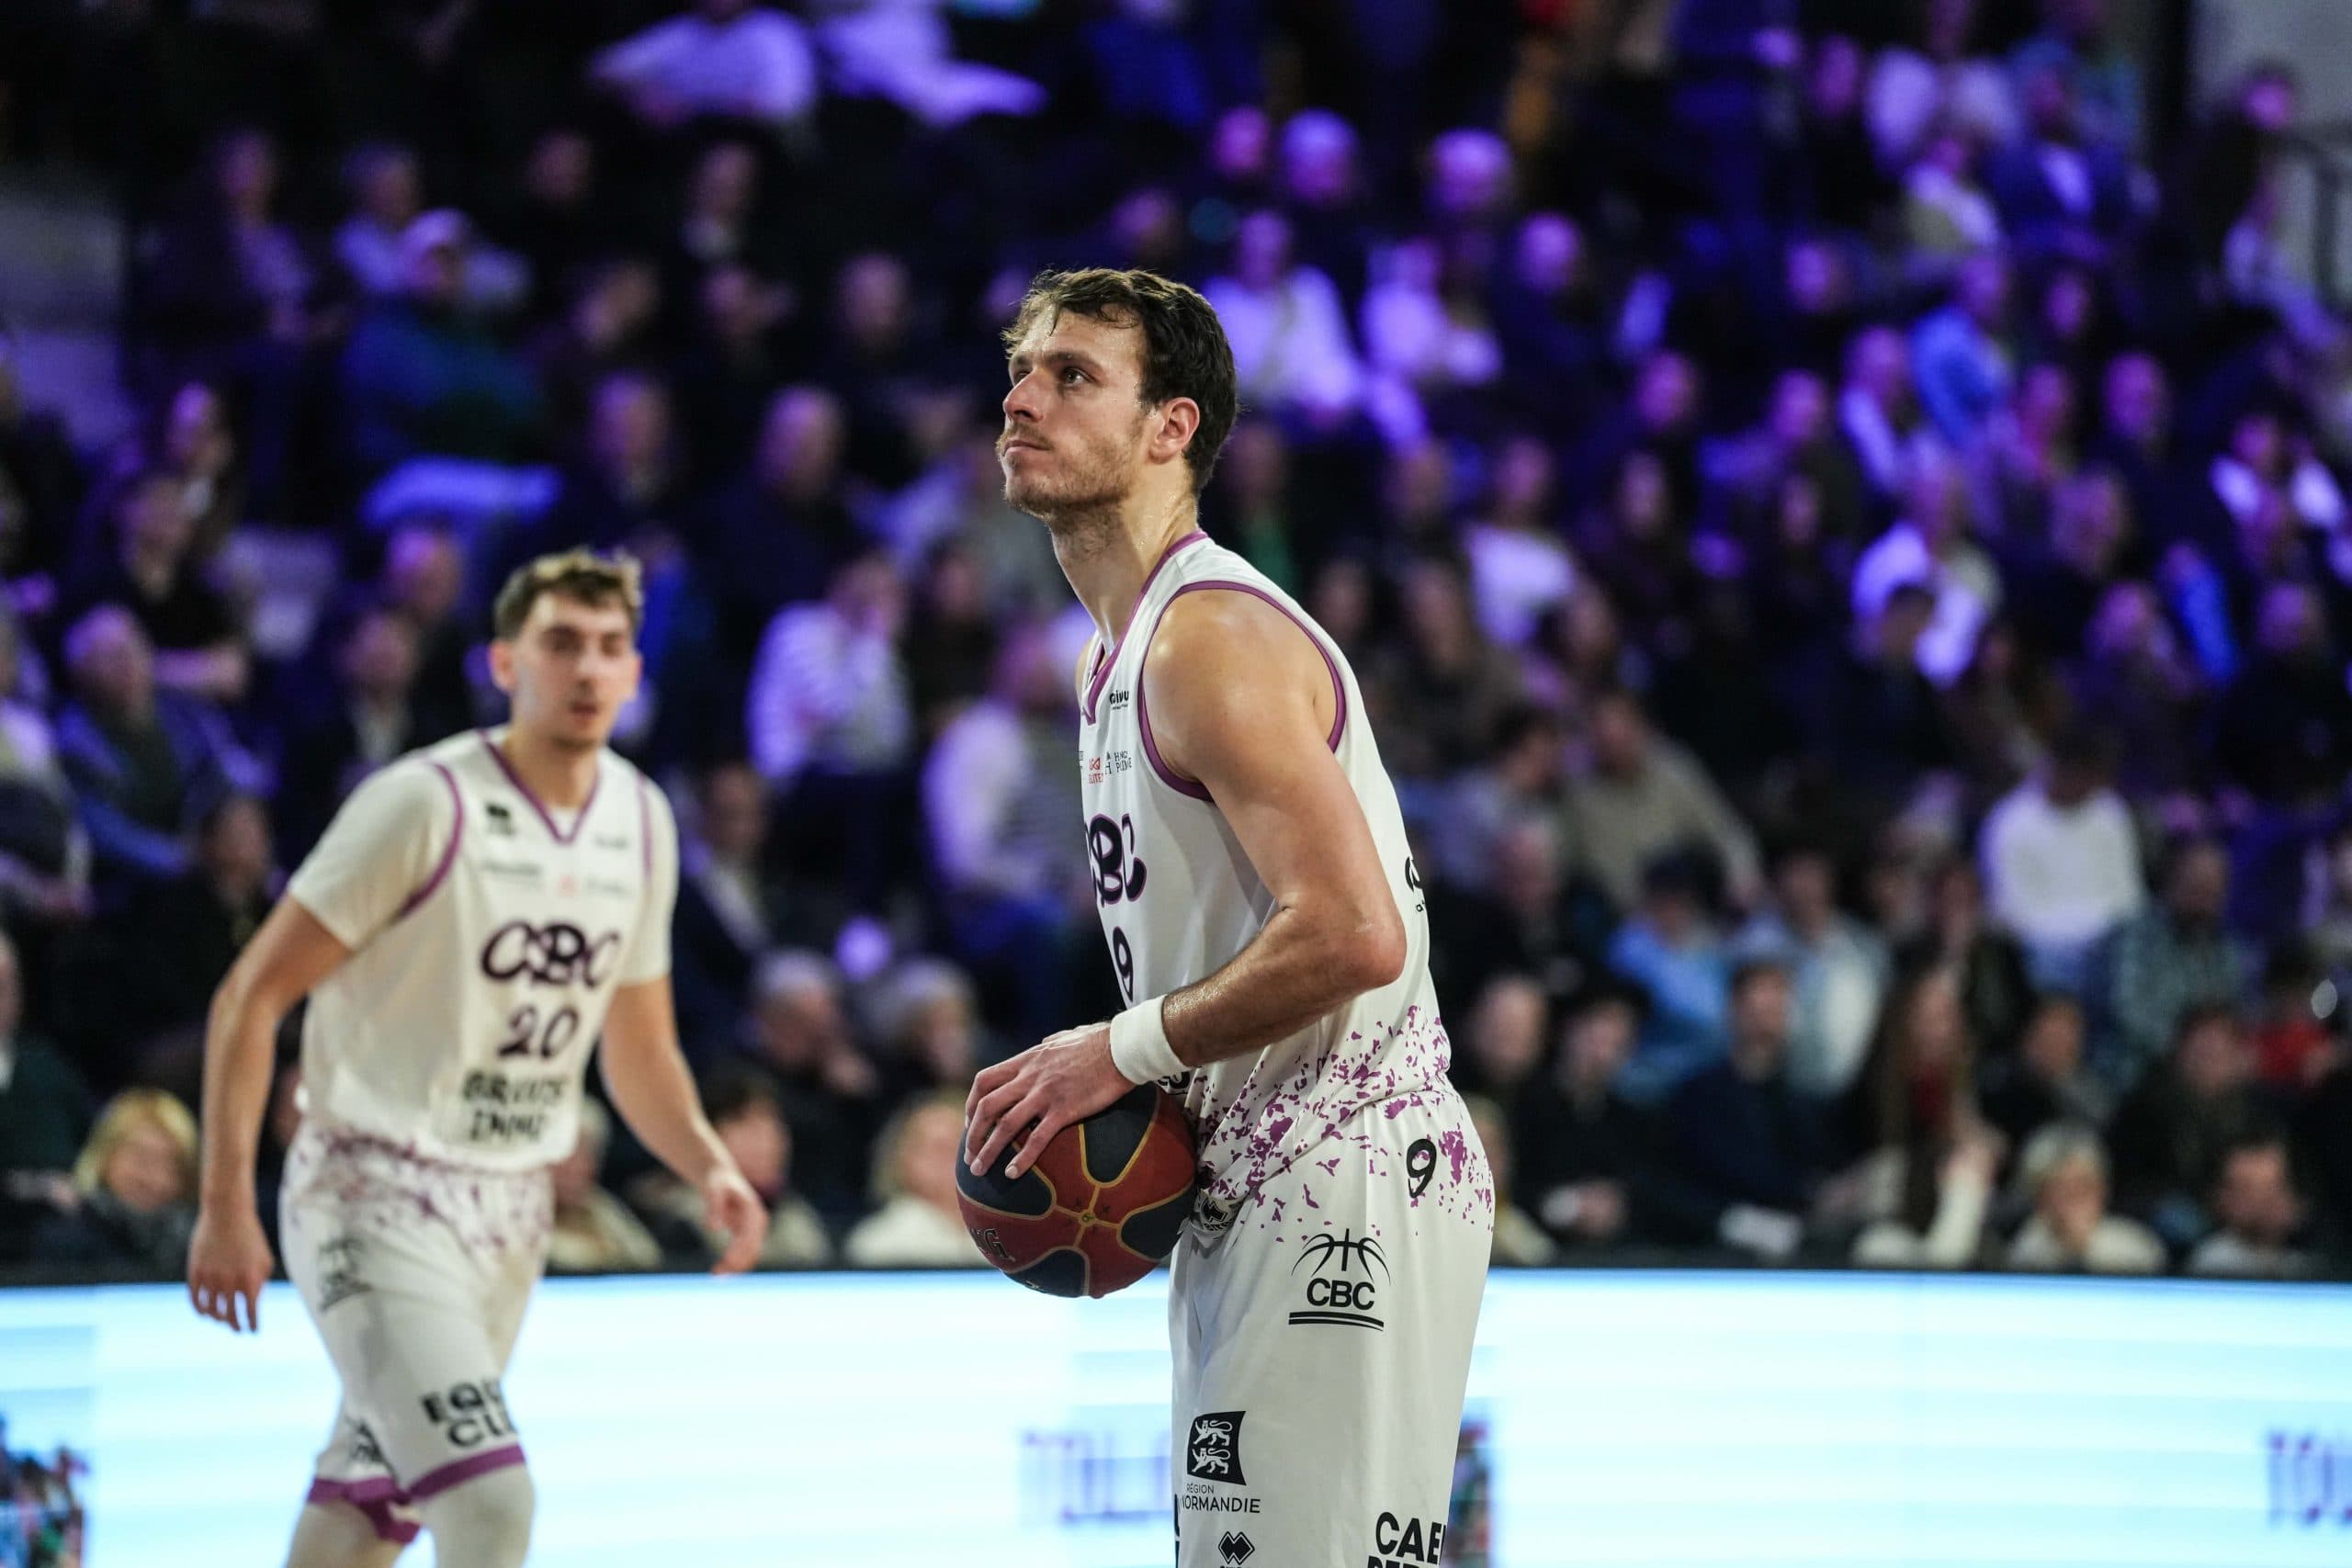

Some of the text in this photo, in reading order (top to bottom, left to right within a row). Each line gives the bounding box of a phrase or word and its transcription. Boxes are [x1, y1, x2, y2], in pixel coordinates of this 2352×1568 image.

[1113, 926, 1134, 1002] 9
[498, 1005, 580, 1058] 20
[1406, 1138, 1437, 1198] 9
[1306, 1278, 1375, 1311] CBC
[1375, 1512, 1447, 1565] CAE
